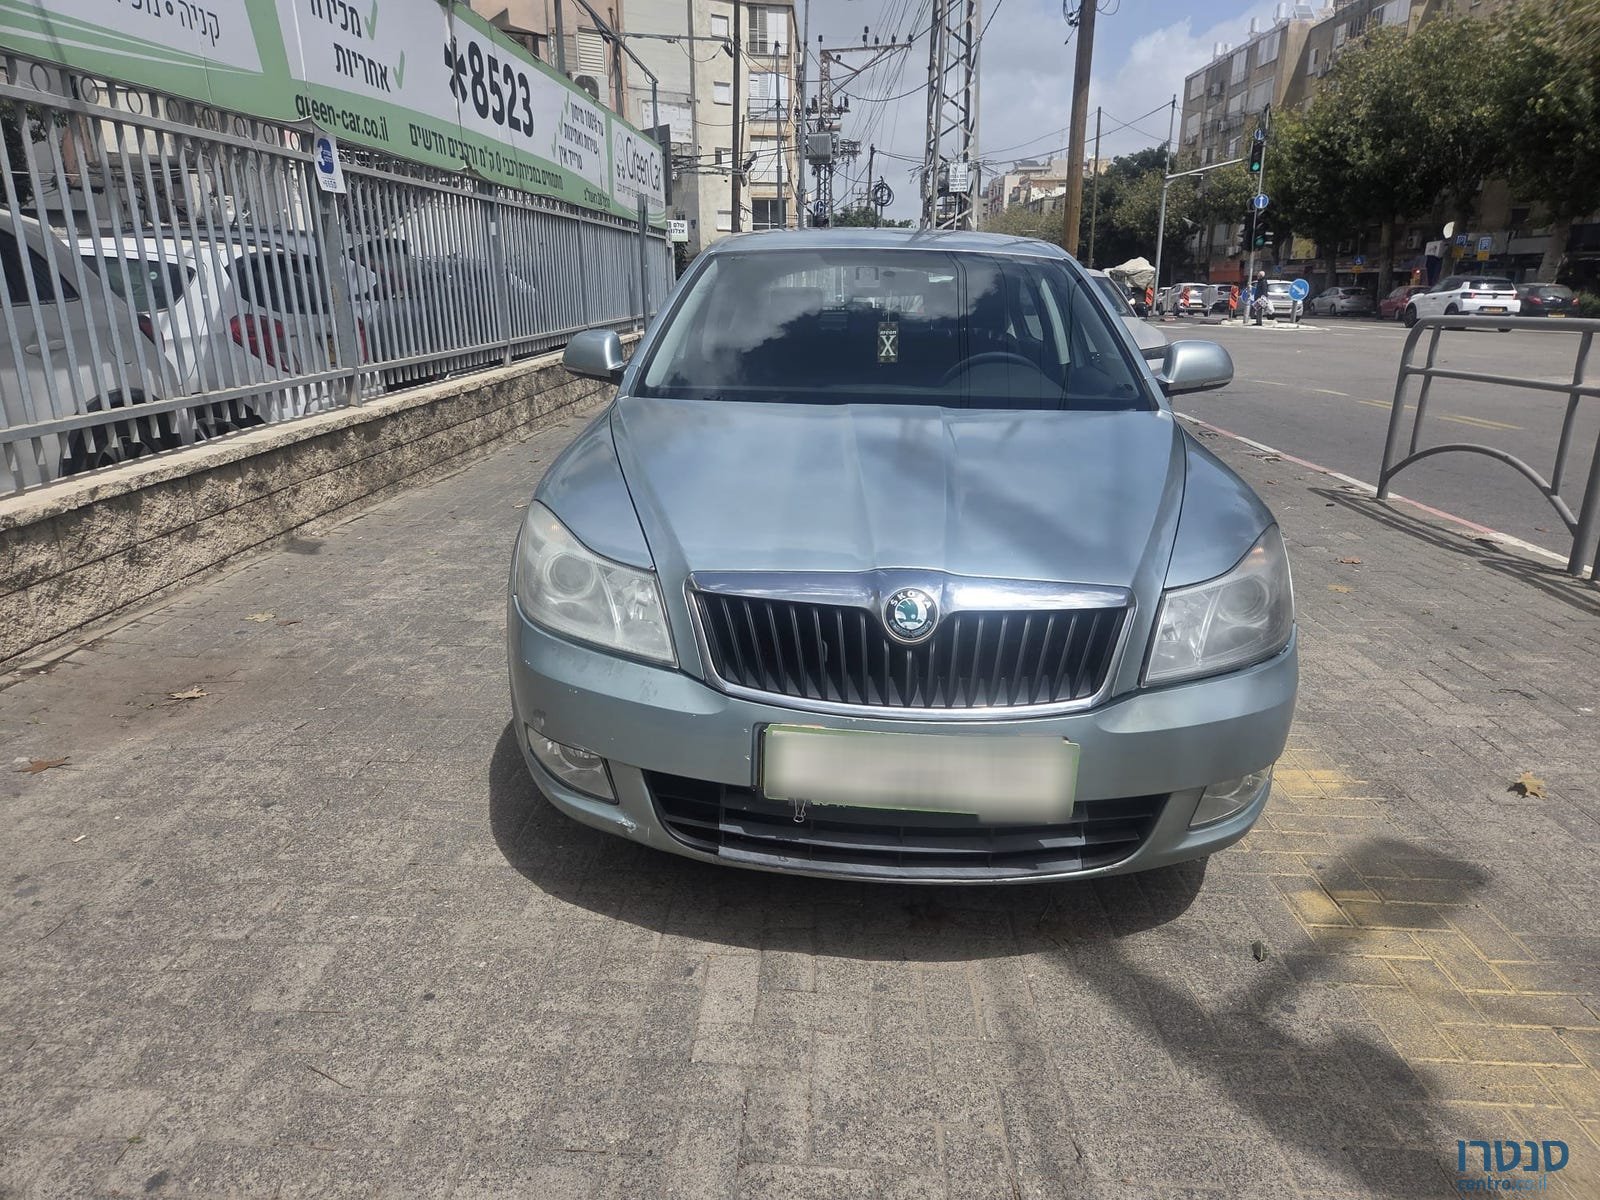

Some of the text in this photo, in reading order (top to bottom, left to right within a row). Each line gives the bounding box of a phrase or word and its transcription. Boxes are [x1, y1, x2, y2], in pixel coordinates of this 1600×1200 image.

[178, 0, 220, 47] קניה
[333, 42, 391, 93] אחריות
[295, 94, 389, 142] green-car.co.il
[408, 123, 446, 155] חדשים
[558, 145, 569, 167] אין
[625, 136, 662, 192] Green Car
[880, 335, 897, 357] X
